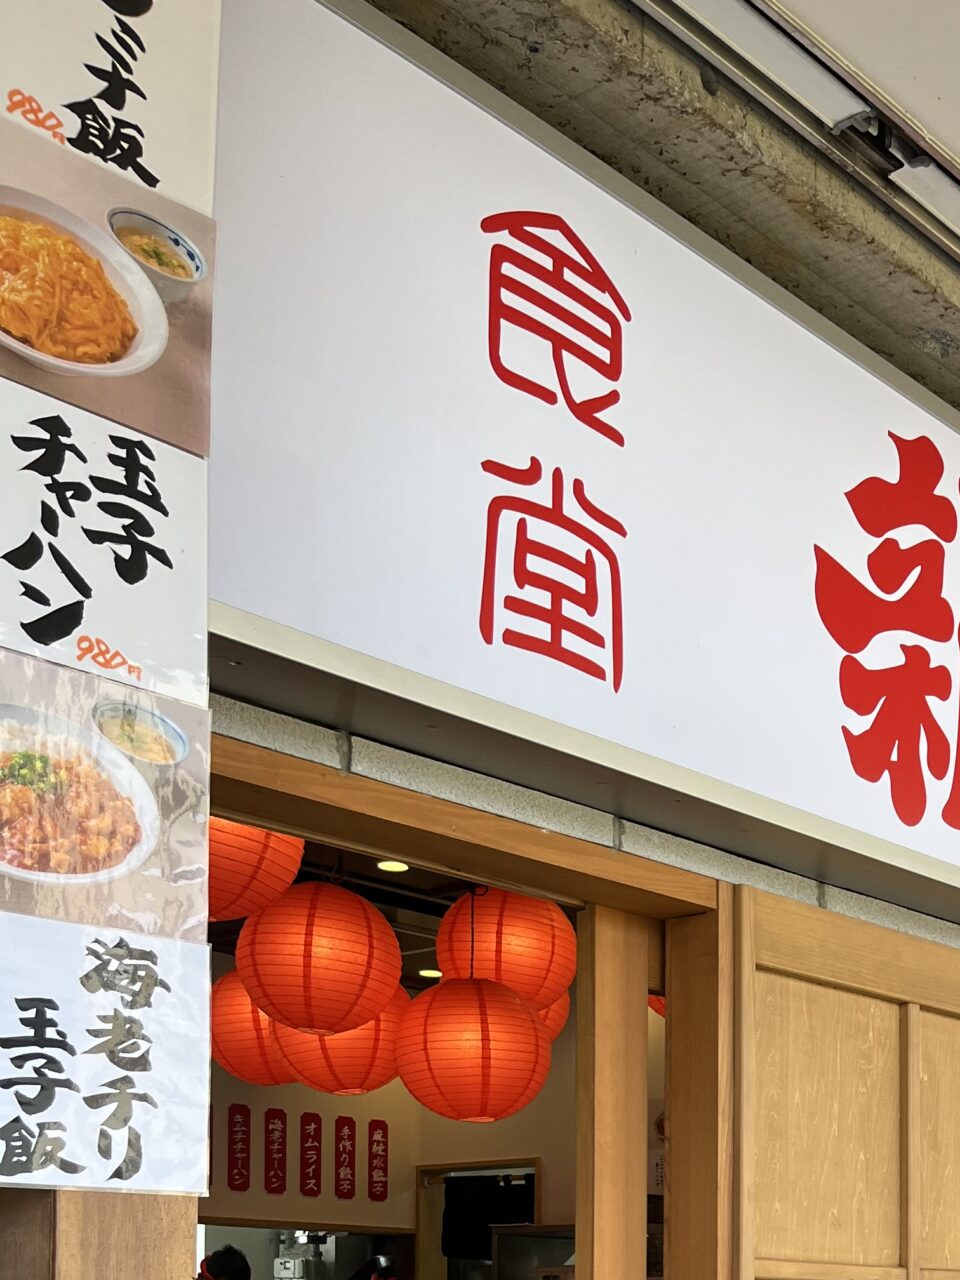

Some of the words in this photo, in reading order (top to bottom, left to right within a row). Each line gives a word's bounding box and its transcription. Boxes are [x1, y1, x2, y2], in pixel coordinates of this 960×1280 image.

[80, 433, 174, 586] 玉子
[479, 211, 632, 694] 食堂
[0, 414, 93, 647] チャーハン
[0, 996, 87, 1177] 玉子飯
[80, 936, 172, 1182] 海老チリ
[232, 1113, 248, 1185] キムチチャーハン
[268, 1118, 284, 1188] 海老チャーハン
[304, 1122, 319, 1191] オムライス
[338, 1125, 353, 1193] 手作り餃子
